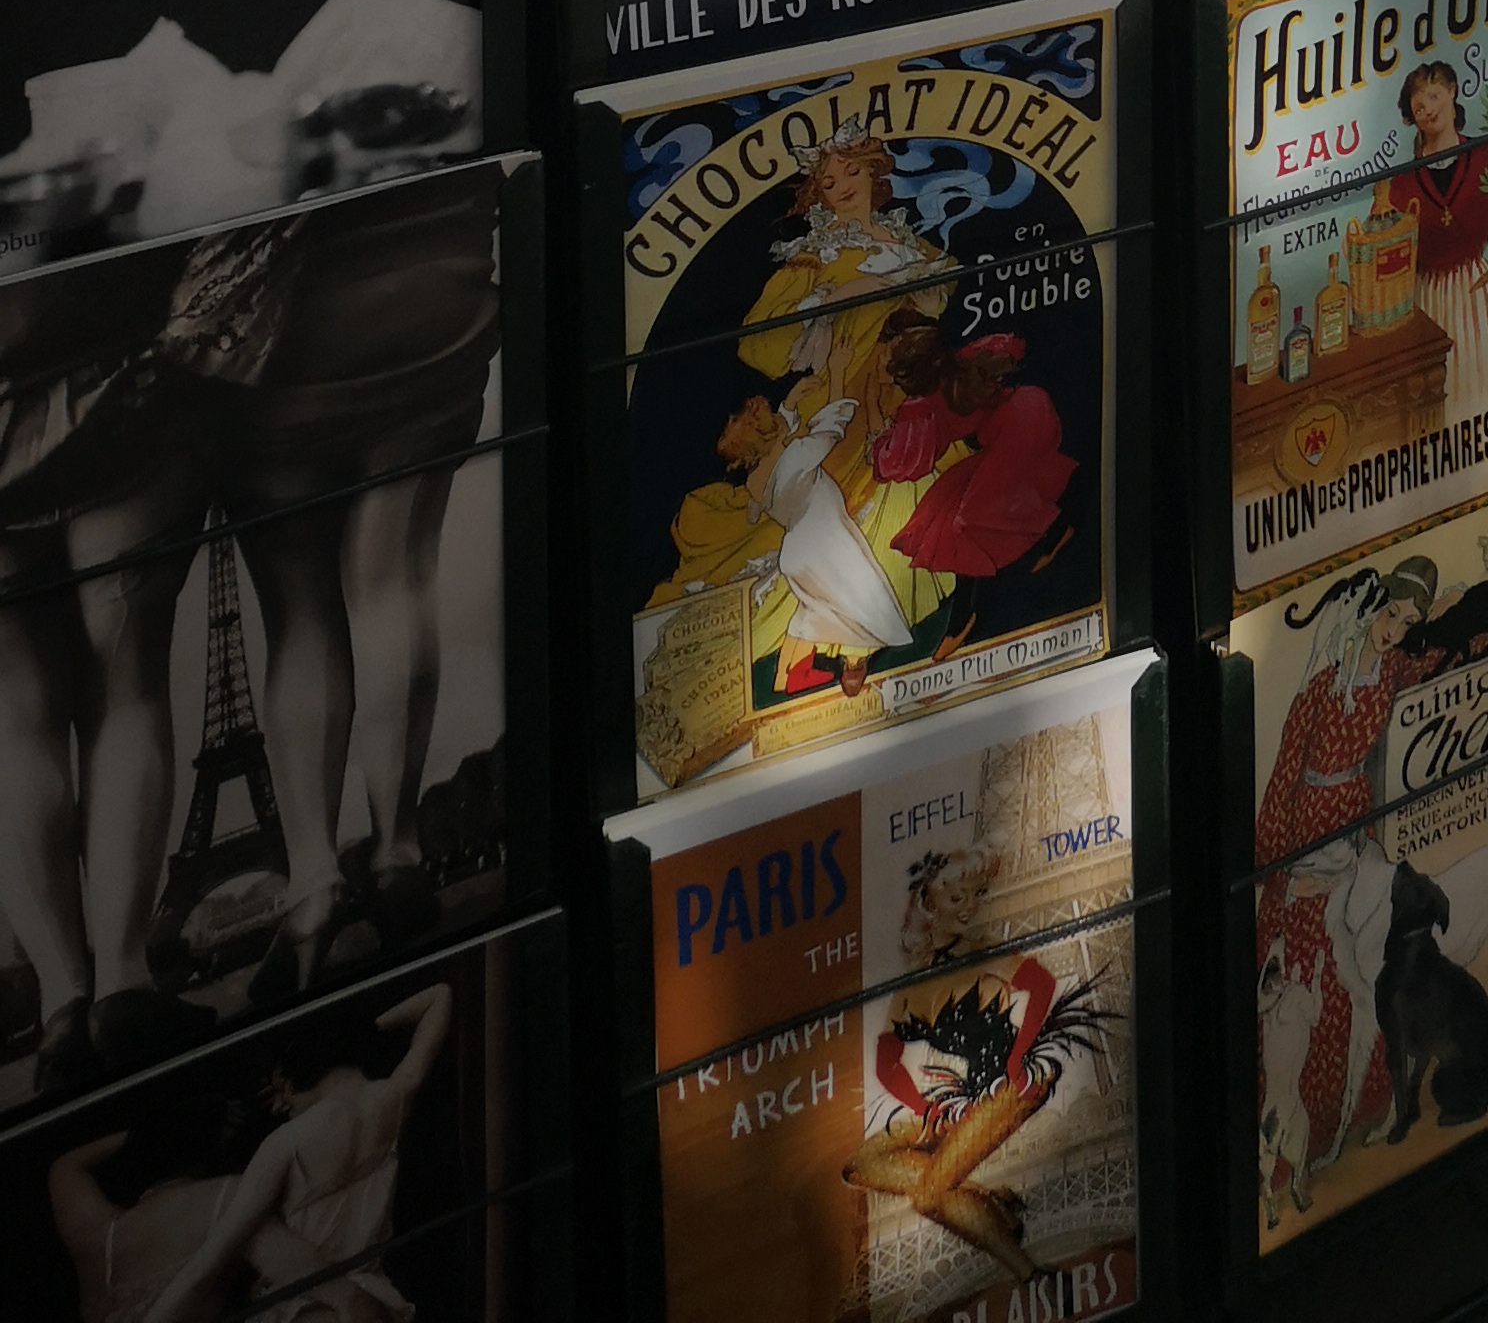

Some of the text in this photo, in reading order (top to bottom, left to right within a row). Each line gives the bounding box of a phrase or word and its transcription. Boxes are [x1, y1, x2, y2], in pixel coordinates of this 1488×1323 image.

[1275, 119, 1362, 179] EAU
[1314, 166, 1330, 178] DE
[625, 78, 1098, 279] CHOCOLAT IDÉAL
[1014, 222, 1046, 243] en
[1283, 217, 1340, 255] EXTRA
[961, 274, 1092, 337] Soluble
[1245, 479, 1316, 554] UNION
[1318, 474, 1347, 515] DES
[893, 668, 954, 702] Donne
[889, 791, 974, 843] EIFFEL
[1039, 814, 1125, 862] TOWER
[677, 829, 848, 969] PARIS
[804, 932, 860, 976] THE
[729, 1062, 836, 1140] ARCH
